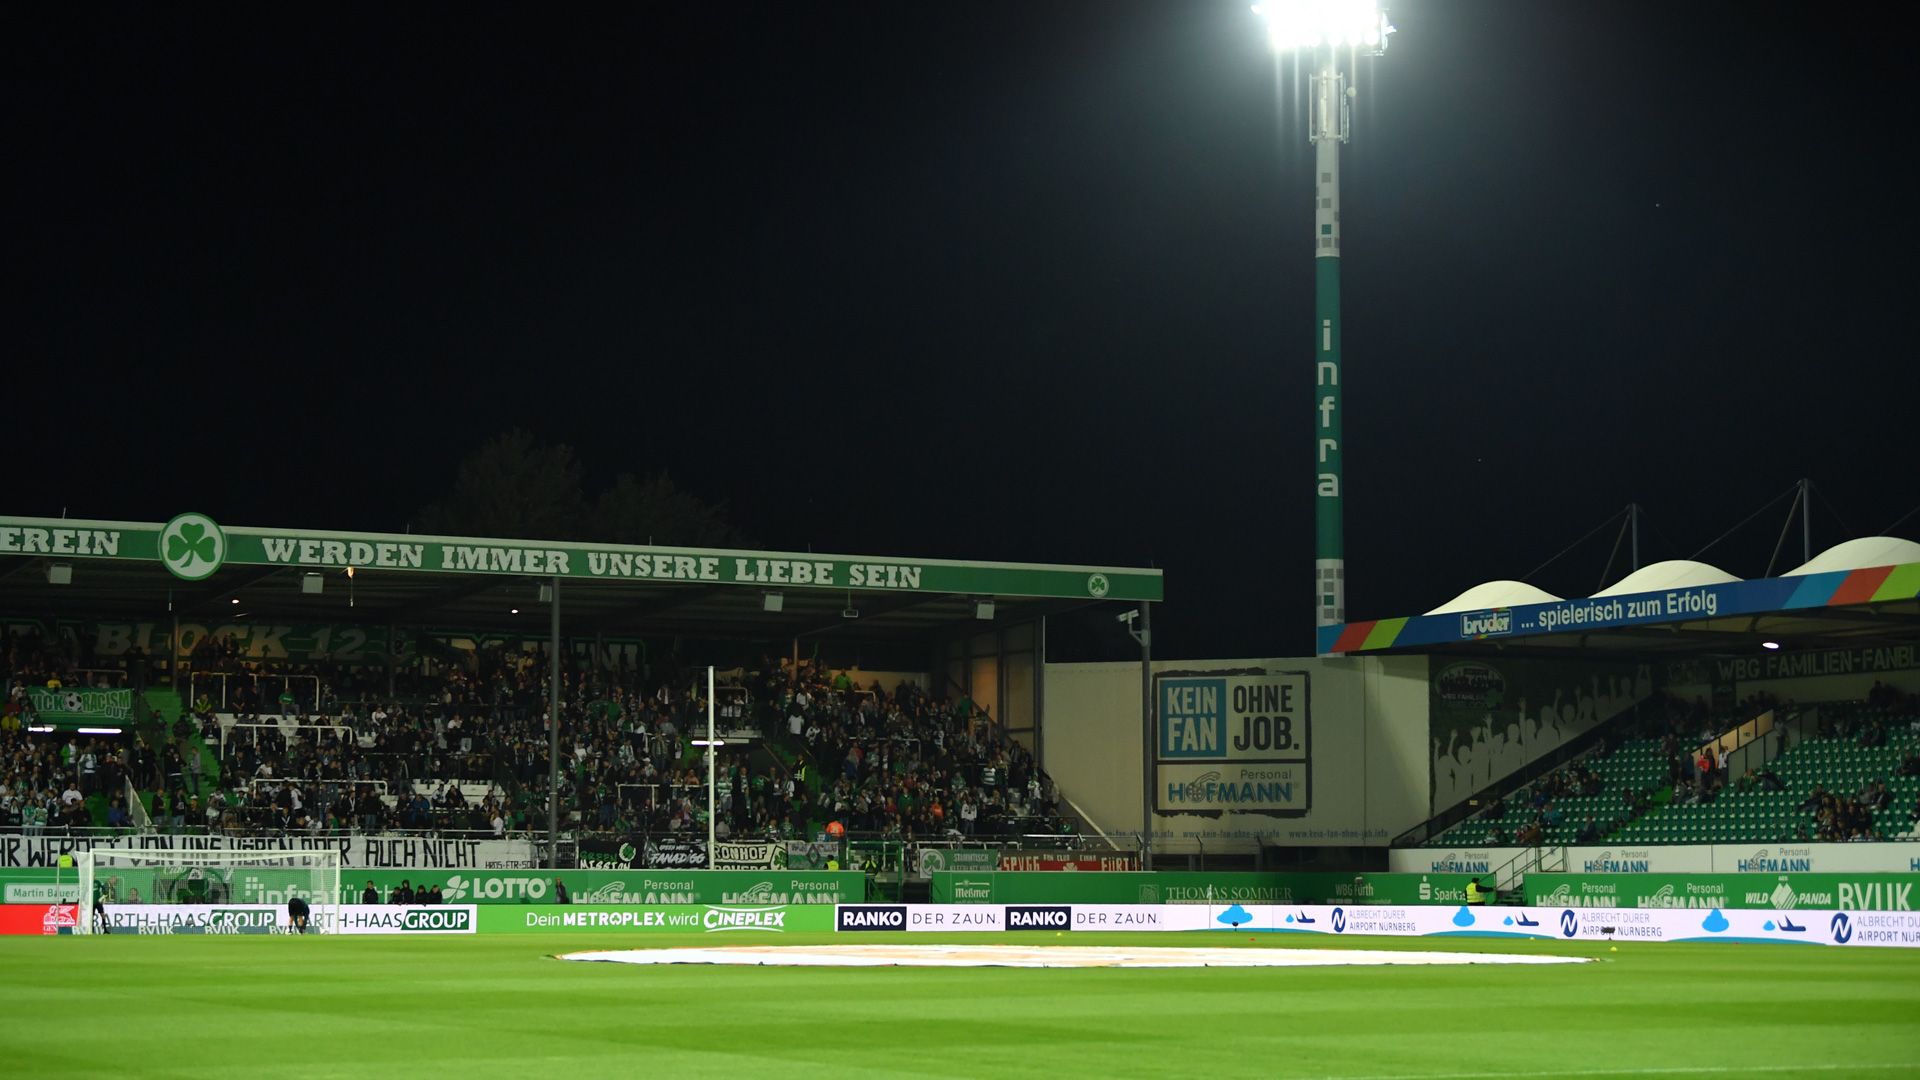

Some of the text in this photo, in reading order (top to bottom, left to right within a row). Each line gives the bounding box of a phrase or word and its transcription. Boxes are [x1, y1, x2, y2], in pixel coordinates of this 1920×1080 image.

[1317, 319, 1339, 497] infra
[0, 527, 922, 589] EREIN WERDEN IMMER UNSERE LIEBE SEIN
[1538, 600, 1623, 632] spielerisch
[1627, 601, 1661, 618] zum
[1666, 590, 1717, 615] Erfolg
[1462, 611, 1510, 635] bruder
[1717, 659, 1760, 680] WBG
[81, 689, 132, 713] RACISM
[1167, 686, 1217, 714] KEIN
[1233, 685, 1293, 714] OHNE
[1167, 716, 1217, 752] FAN
[1233, 716, 1300, 751] JOB.
[1240, 769, 1292, 780] Personal
[1168, 782, 1292, 803] HOFMANN
[365, 840, 416, 867] AUCH
[423, 840, 481, 869] NICHT
[1464, 852, 1489, 860] Personal
[1620, 850, 1649, 858] Personal
[1779, 848, 1810, 856] Personal
[473, 877, 547, 899] LOTTO
[643, 879, 695, 891] Personal
[790, 879, 840, 891] Personal
[1581, 882, 1617, 894] Personal
[1686, 882, 1725, 894] Personal
[14, 888, 44, 897] Martin
[47, 888, 75, 898] Bauer
[1165, 886, 1293, 900] THOMAS SOMMER
[1744, 892, 1832, 905] WILD PANDA
[526, 909, 787, 929] Dein METROPLEX wird CINEPLEX
[843, 911, 1001, 927] RANKO DER ZAUN.
[1009, 911, 1163, 927] RANKO DER ZAUN.
[1349, 909, 1381, 919] ALBRECHT
[1581, 912, 1620, 923] ALBRECHT
[1857, 915, 1905, 927] ALBRECHT
[1349, 922, 1377, 931] AIRPORT
[1858, 930, 1898, 942] AIRPORT
